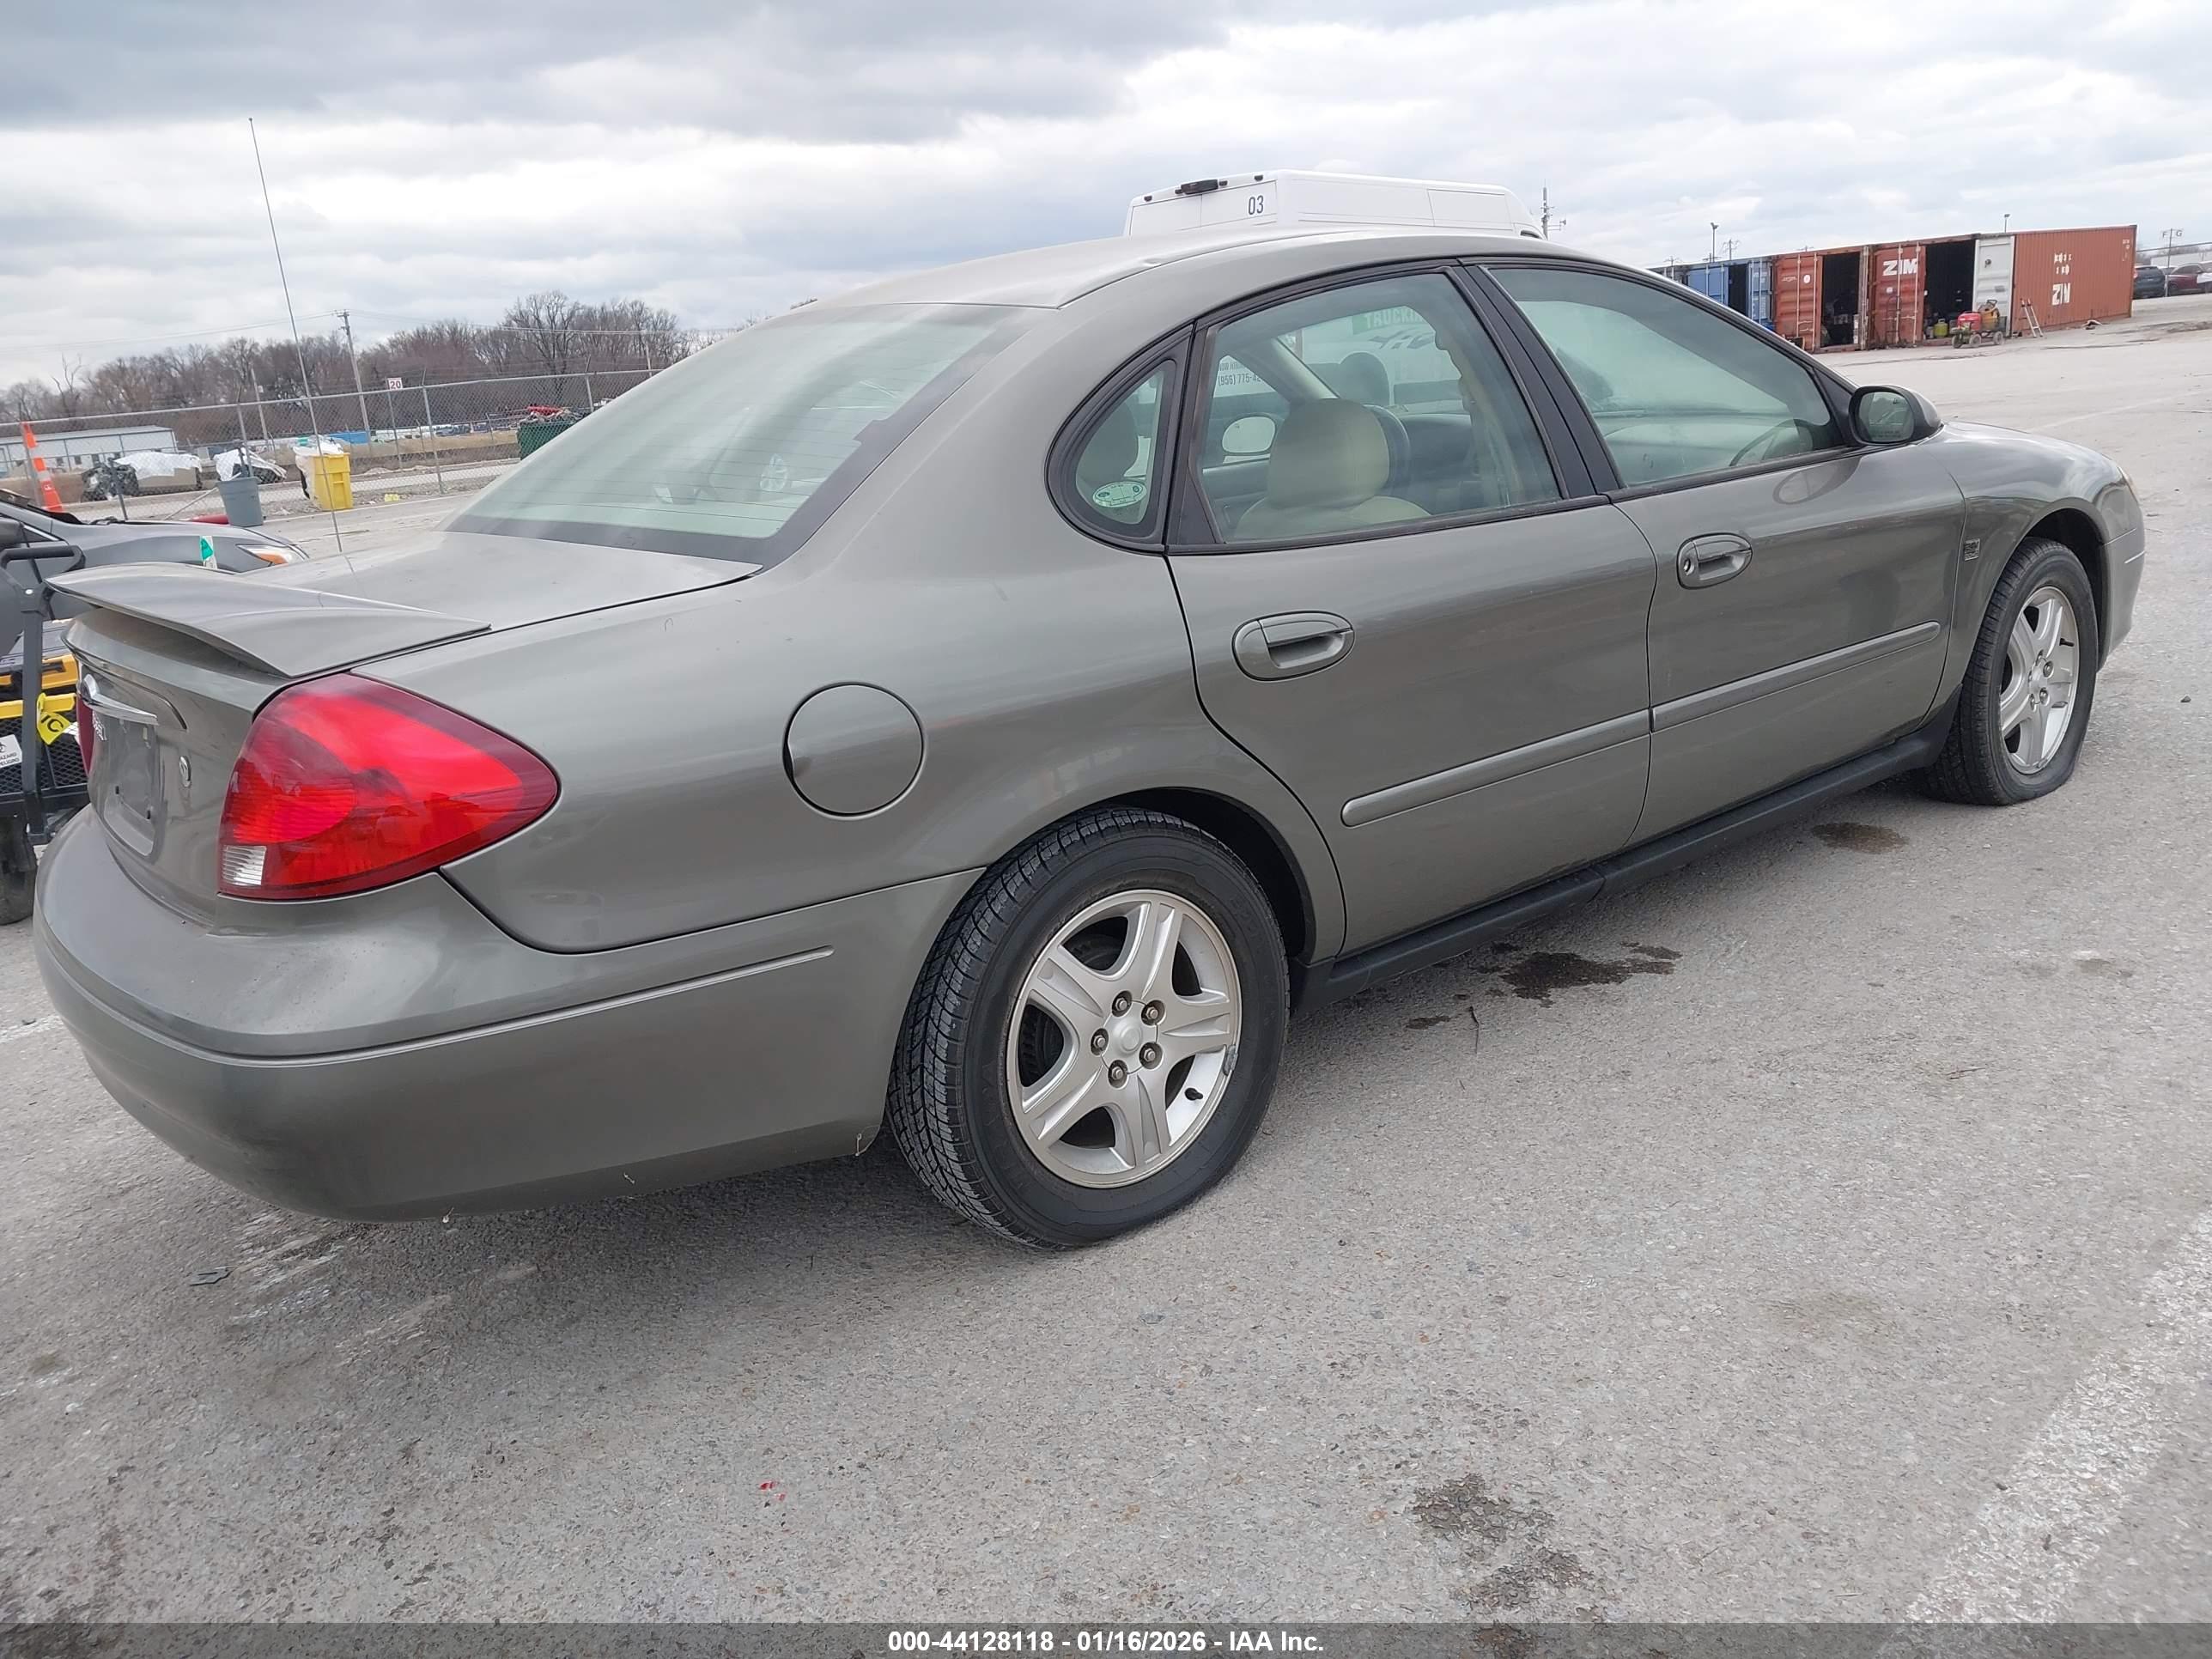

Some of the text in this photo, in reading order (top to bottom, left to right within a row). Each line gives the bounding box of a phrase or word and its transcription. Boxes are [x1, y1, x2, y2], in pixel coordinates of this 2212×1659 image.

[1249, 195, 1264, 215] 03
[1882, 258, 1918, 276] ZIM
[390, 380, 402, 390] 20
[1218, 374, 1237, 386] (956)
